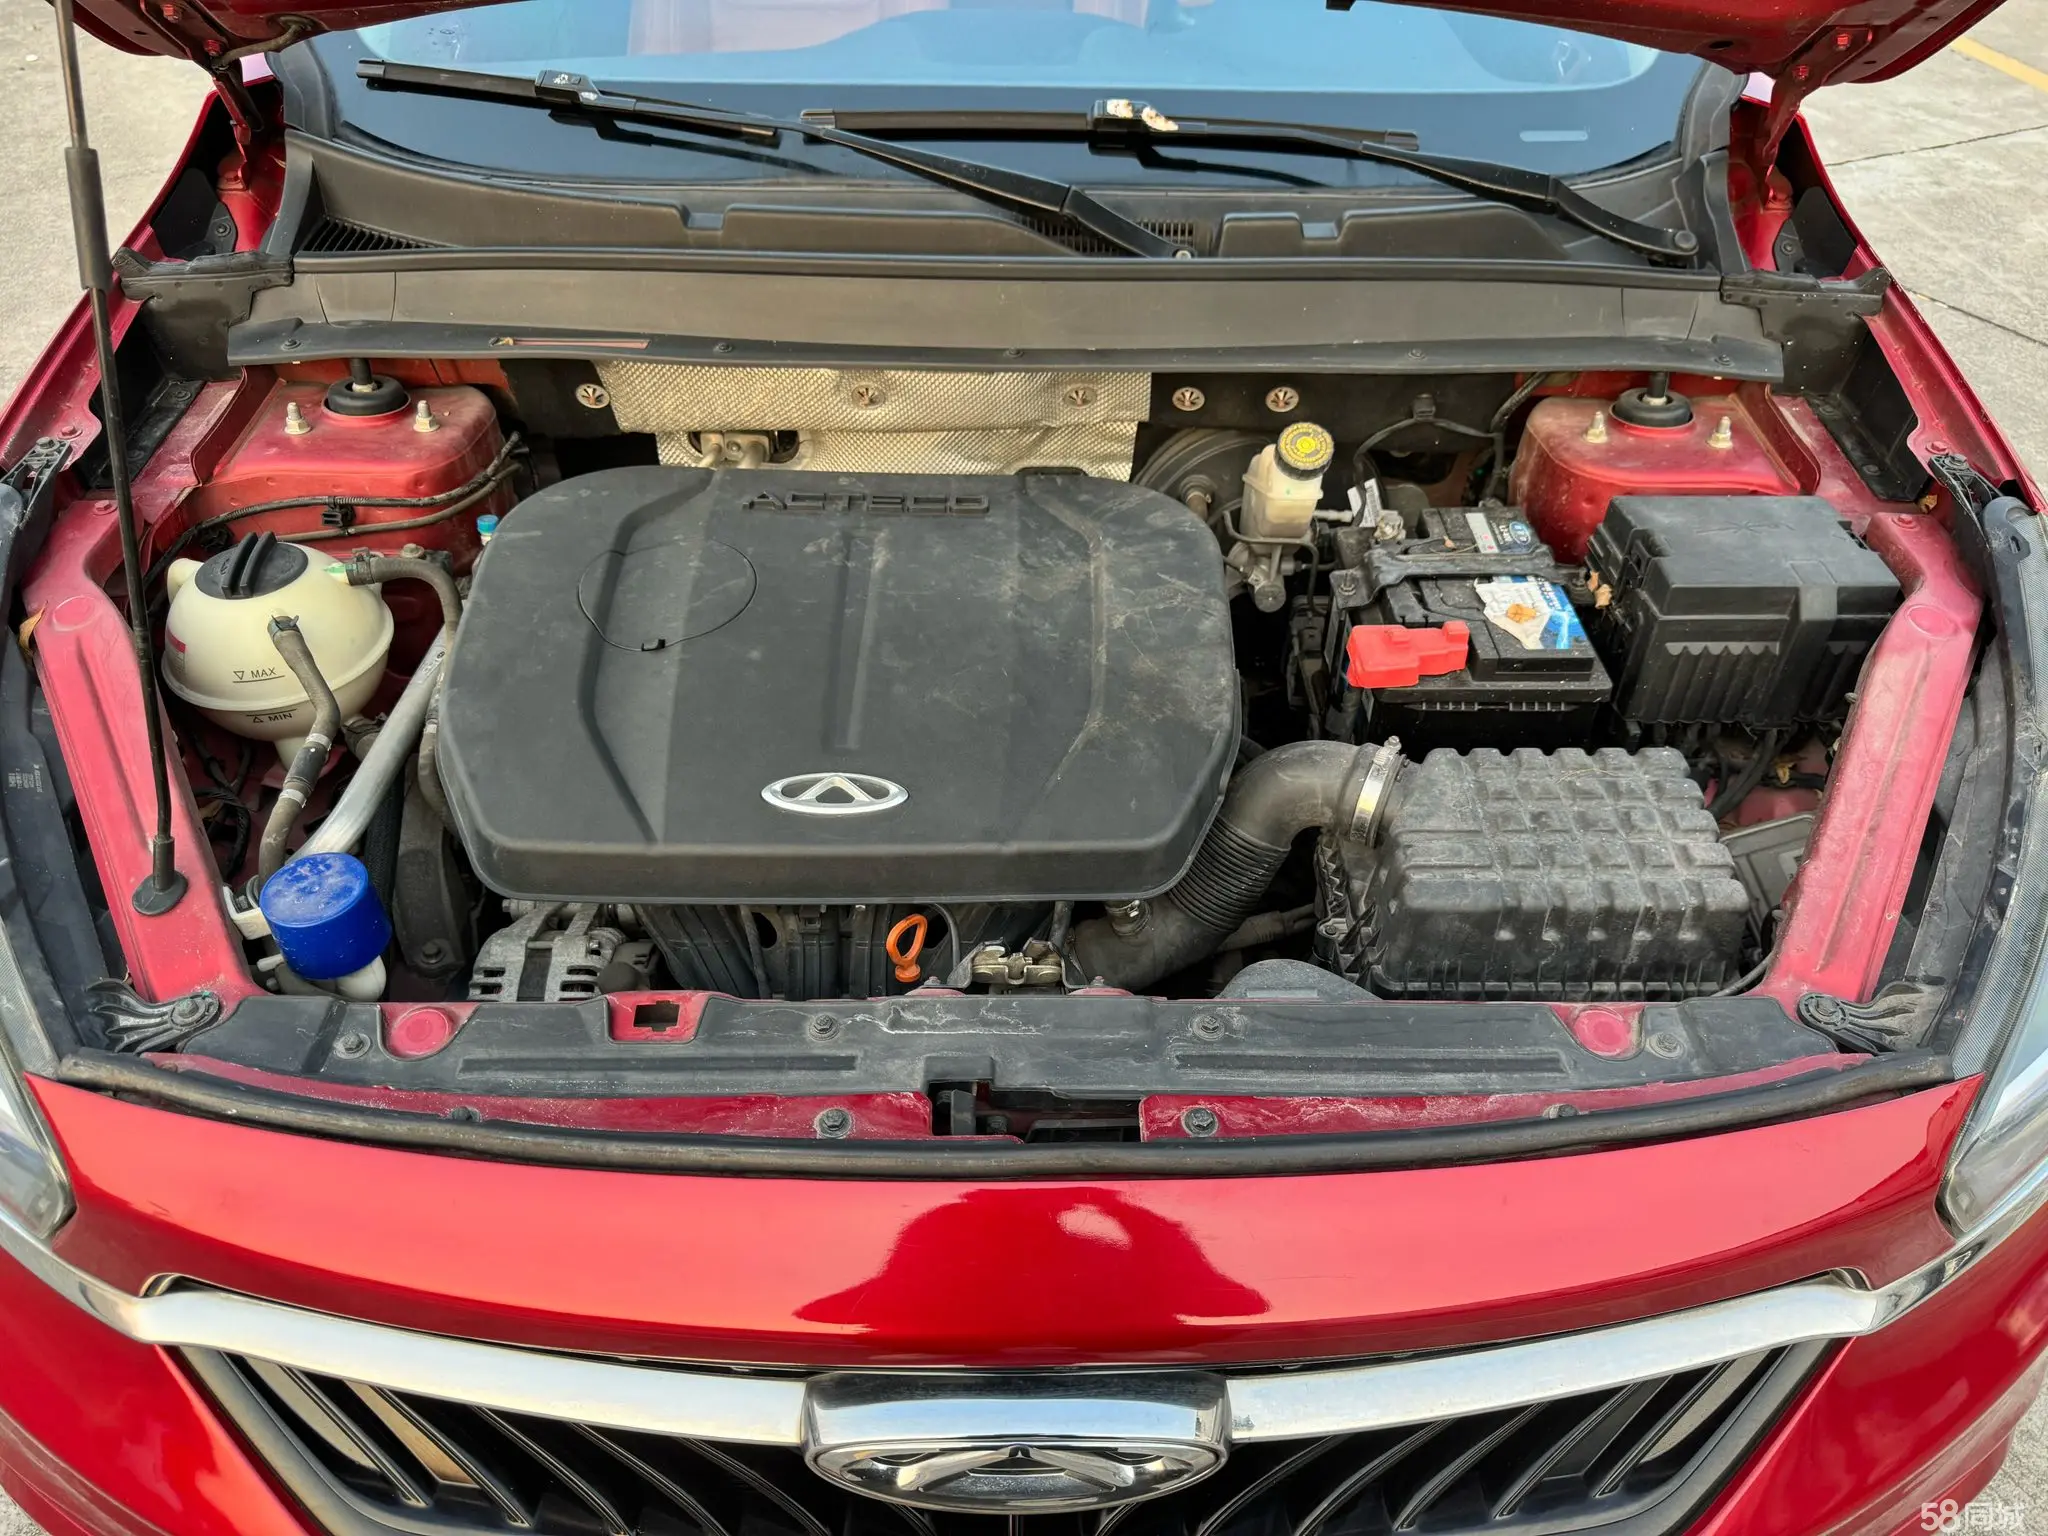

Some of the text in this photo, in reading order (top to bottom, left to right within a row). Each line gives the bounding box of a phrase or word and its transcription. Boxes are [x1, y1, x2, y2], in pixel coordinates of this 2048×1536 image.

[743, 491, 990, 514] ACTECO
[250, 667, 277, 679] MAX
[268, 712, 293, 722] MIN
